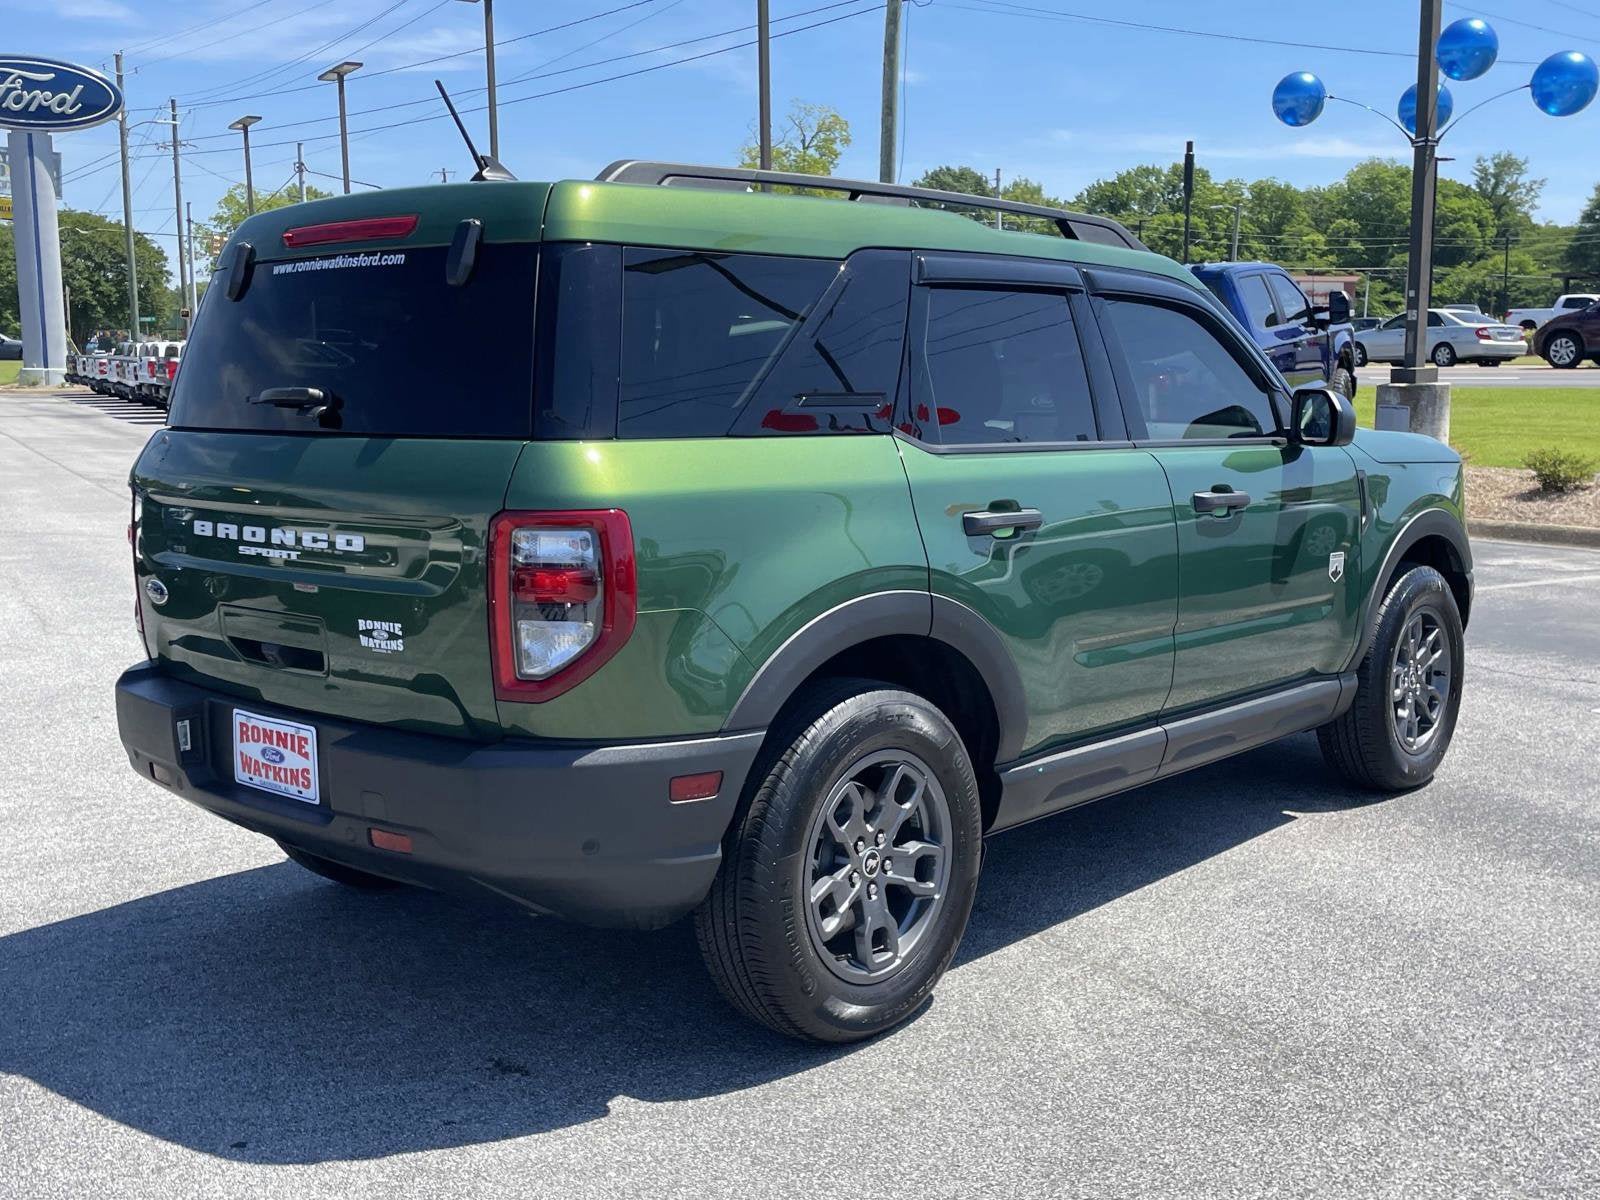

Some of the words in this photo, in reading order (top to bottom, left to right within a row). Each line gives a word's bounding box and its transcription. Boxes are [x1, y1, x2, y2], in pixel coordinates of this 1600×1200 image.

[0, 67, 84, 115] Ford
[273, 252, 405, 275] www.ronniewatkinsford.com
[193, 519, 365, 552] BRONCO
[238, 545, 301, 560] SPORT
[358, 619, 403, 636] RONNIE
[360, 634, 404, 652] WATKINS
[239, 721, 309, 760] RONNIE
[264, 749, 281, 762] Ford
[240, 750, 311, 790] WATKINS
